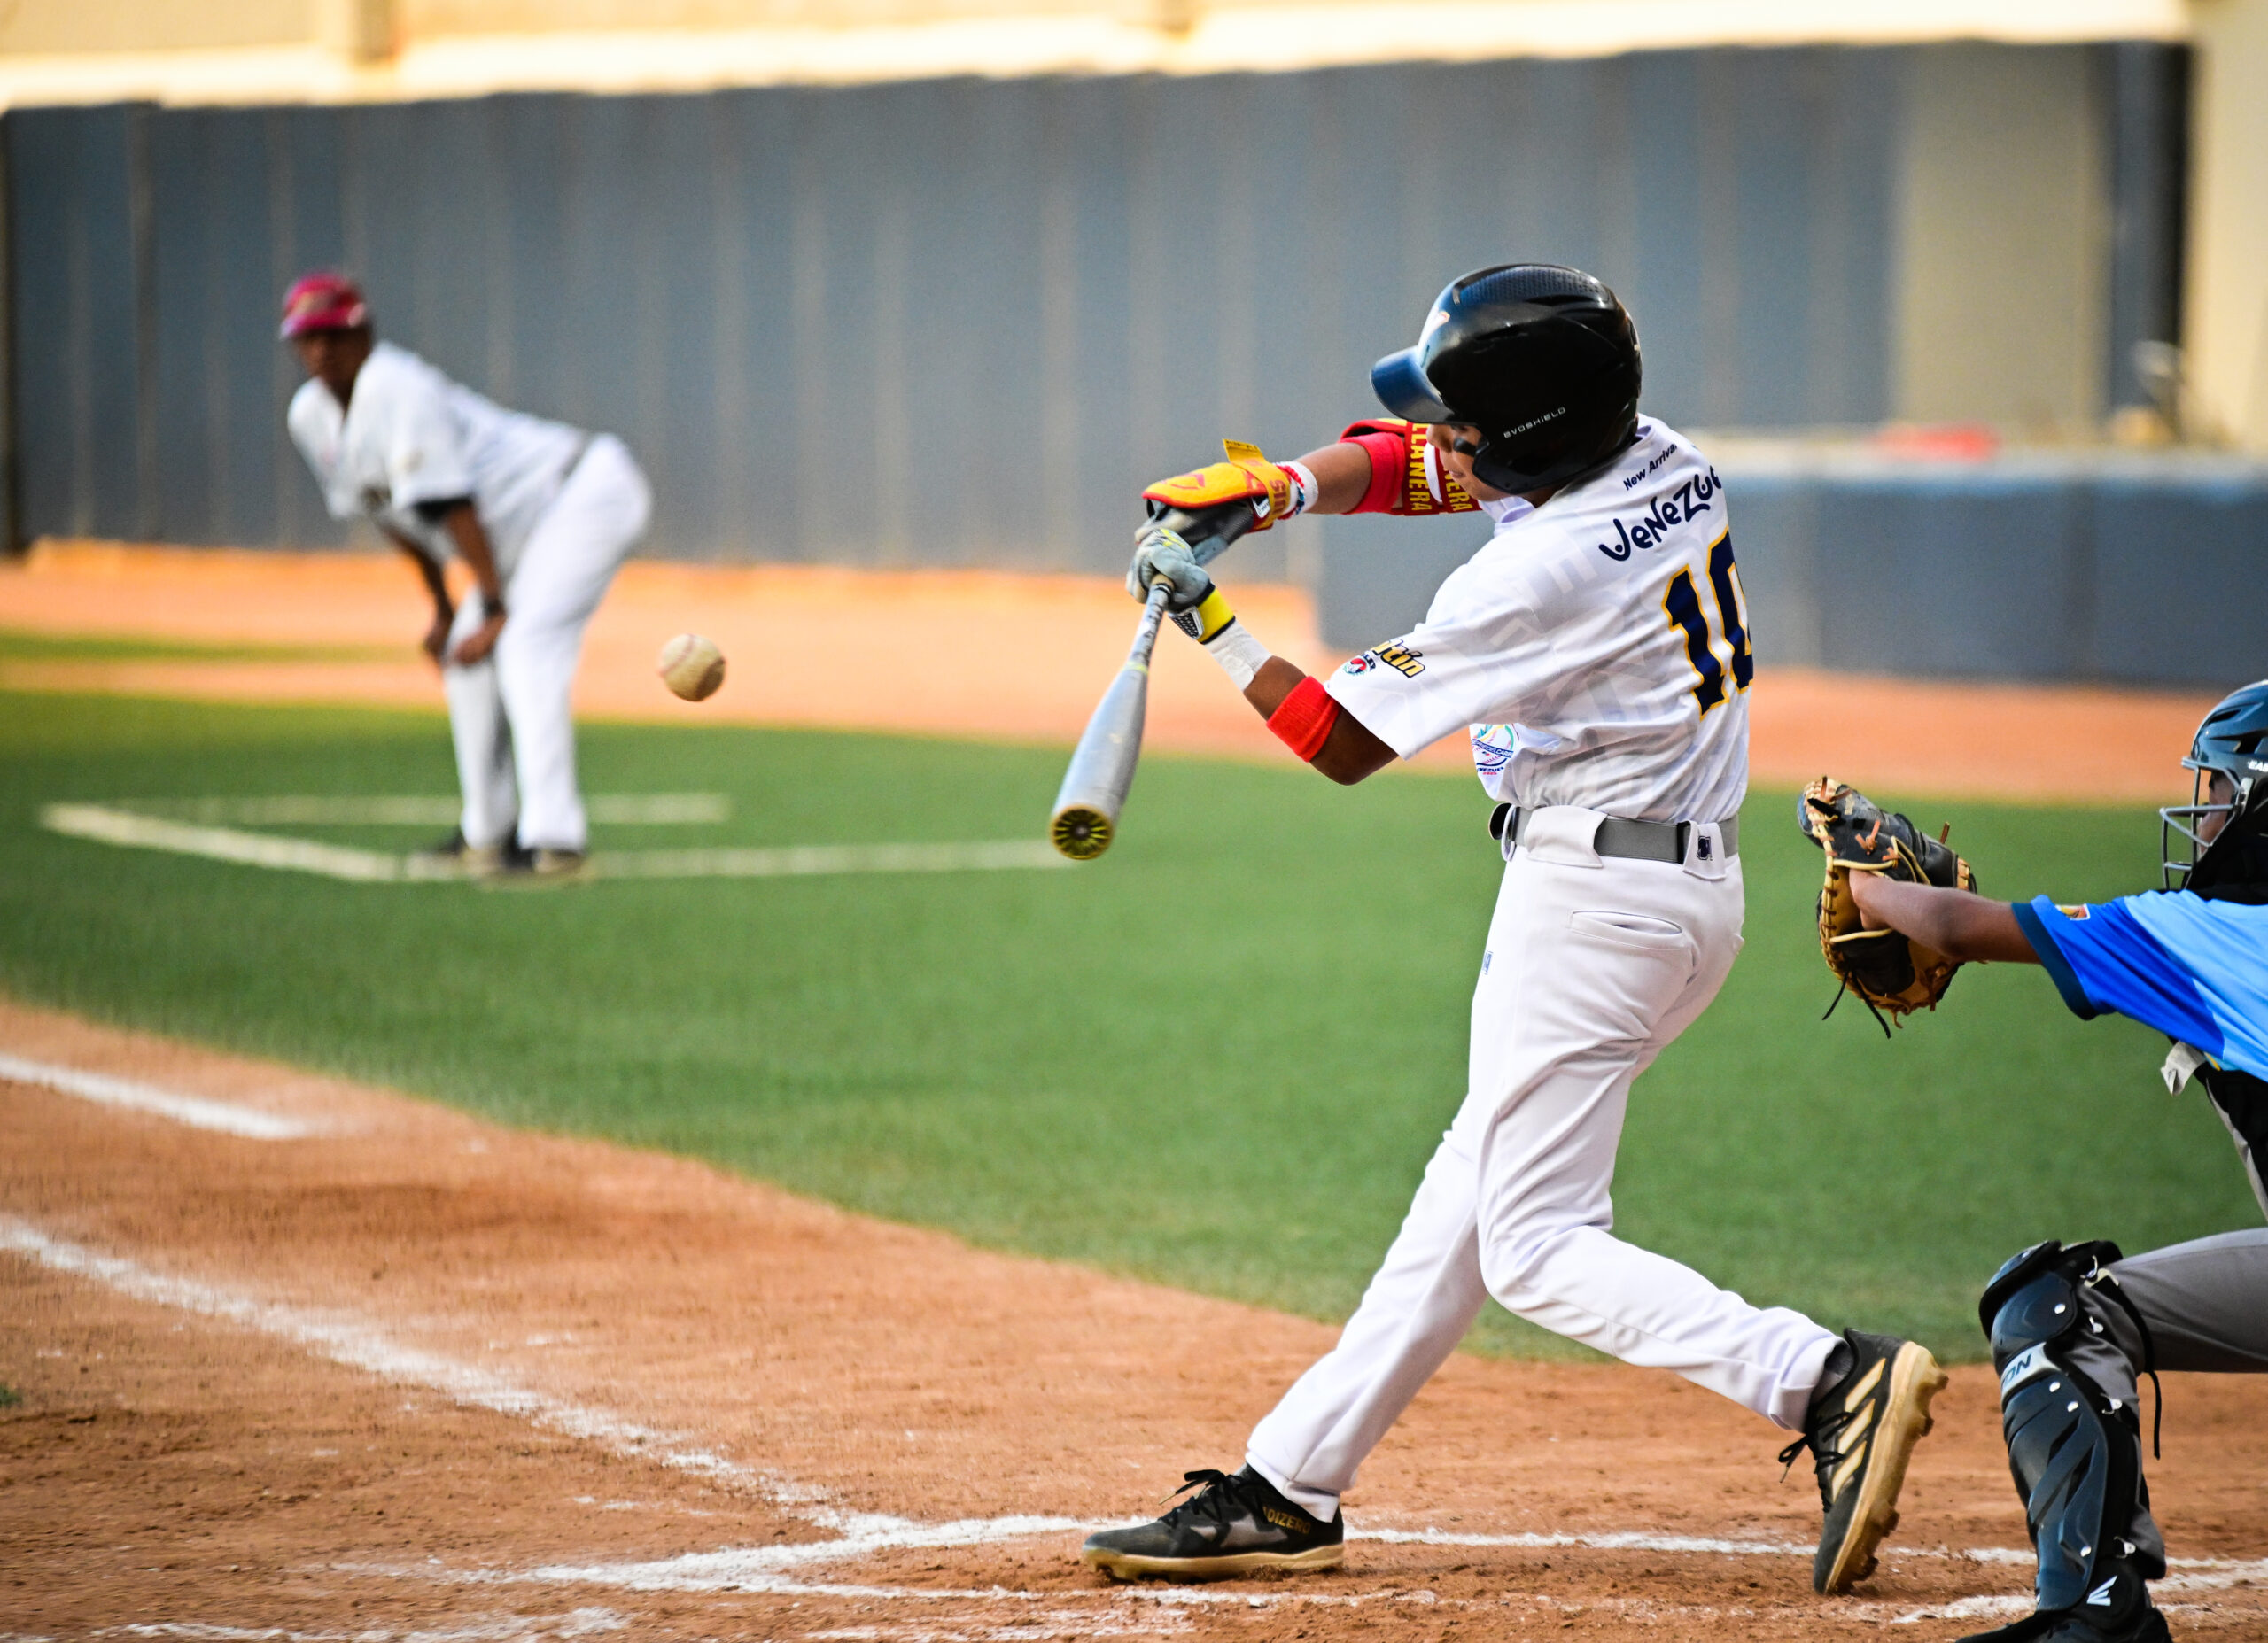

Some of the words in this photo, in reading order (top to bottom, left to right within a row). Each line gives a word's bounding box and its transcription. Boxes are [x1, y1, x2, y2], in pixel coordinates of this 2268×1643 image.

[1503, 407, 1565, 438] EVOSHIELD
[1623, 469, 1646, 491] New
[1649, 443, 1678, 474] Arriva
